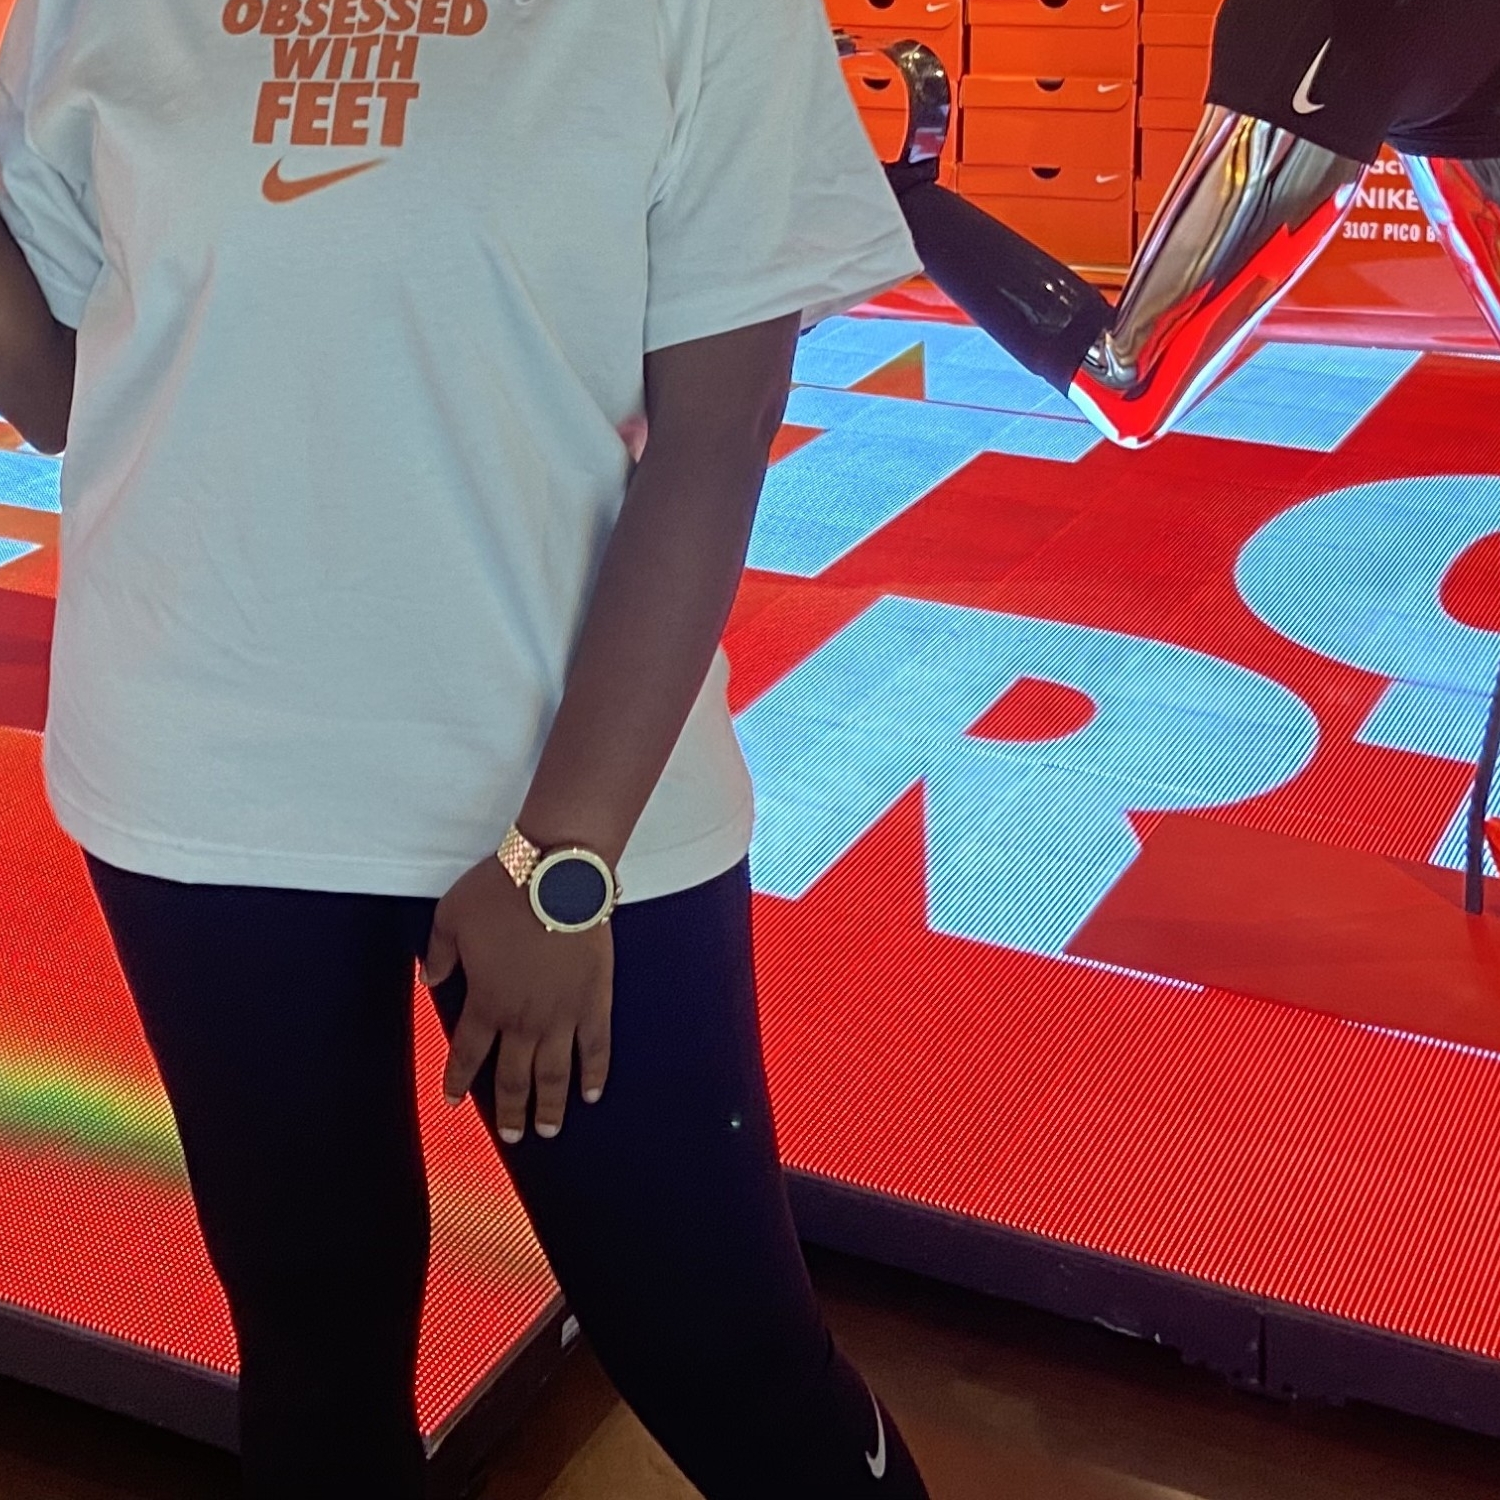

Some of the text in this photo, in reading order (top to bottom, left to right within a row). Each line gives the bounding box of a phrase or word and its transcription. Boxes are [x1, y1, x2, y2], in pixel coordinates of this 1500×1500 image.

[273, 33, 420, 80] WITH
[252, 81, 420, 147] FEET
[1356, 187, 1420, 211] NIKE
[1342, 221, 1379, 240] 3107
[1383, 223, 1421, 243] PICO
